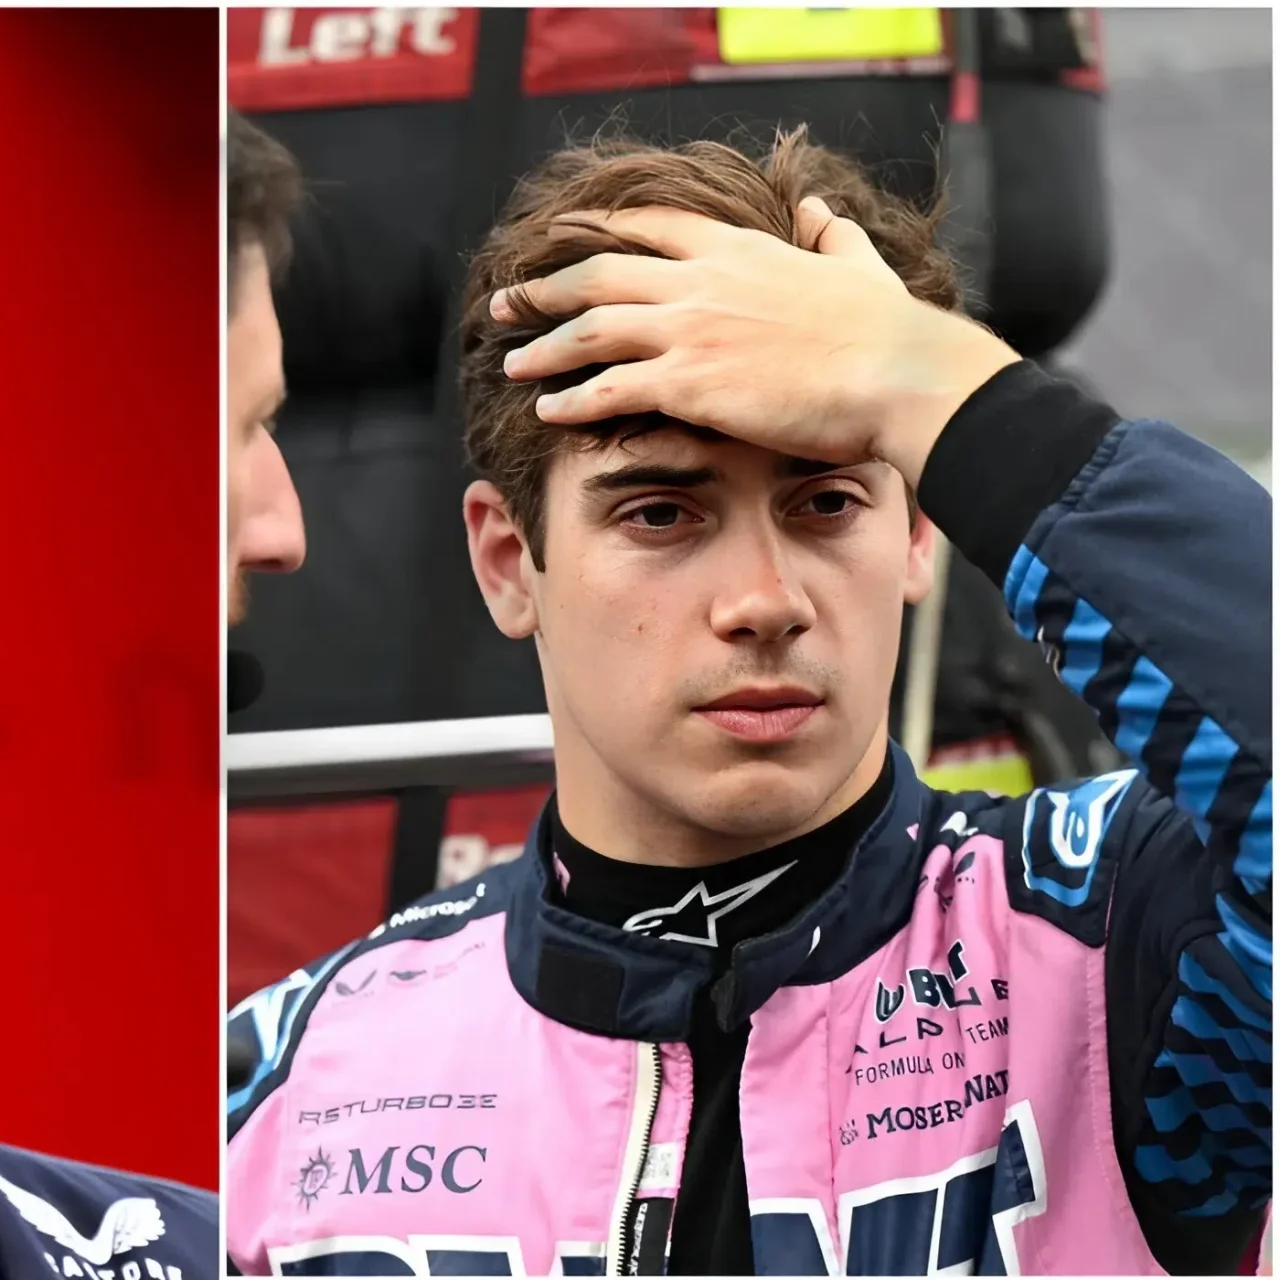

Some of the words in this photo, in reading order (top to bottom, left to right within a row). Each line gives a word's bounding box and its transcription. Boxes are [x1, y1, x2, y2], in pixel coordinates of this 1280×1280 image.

[257, 8, 459, 68] Left
[866, 1100, 964, 1139] MOSER
[339, 1144, 488, 1196] MSC
